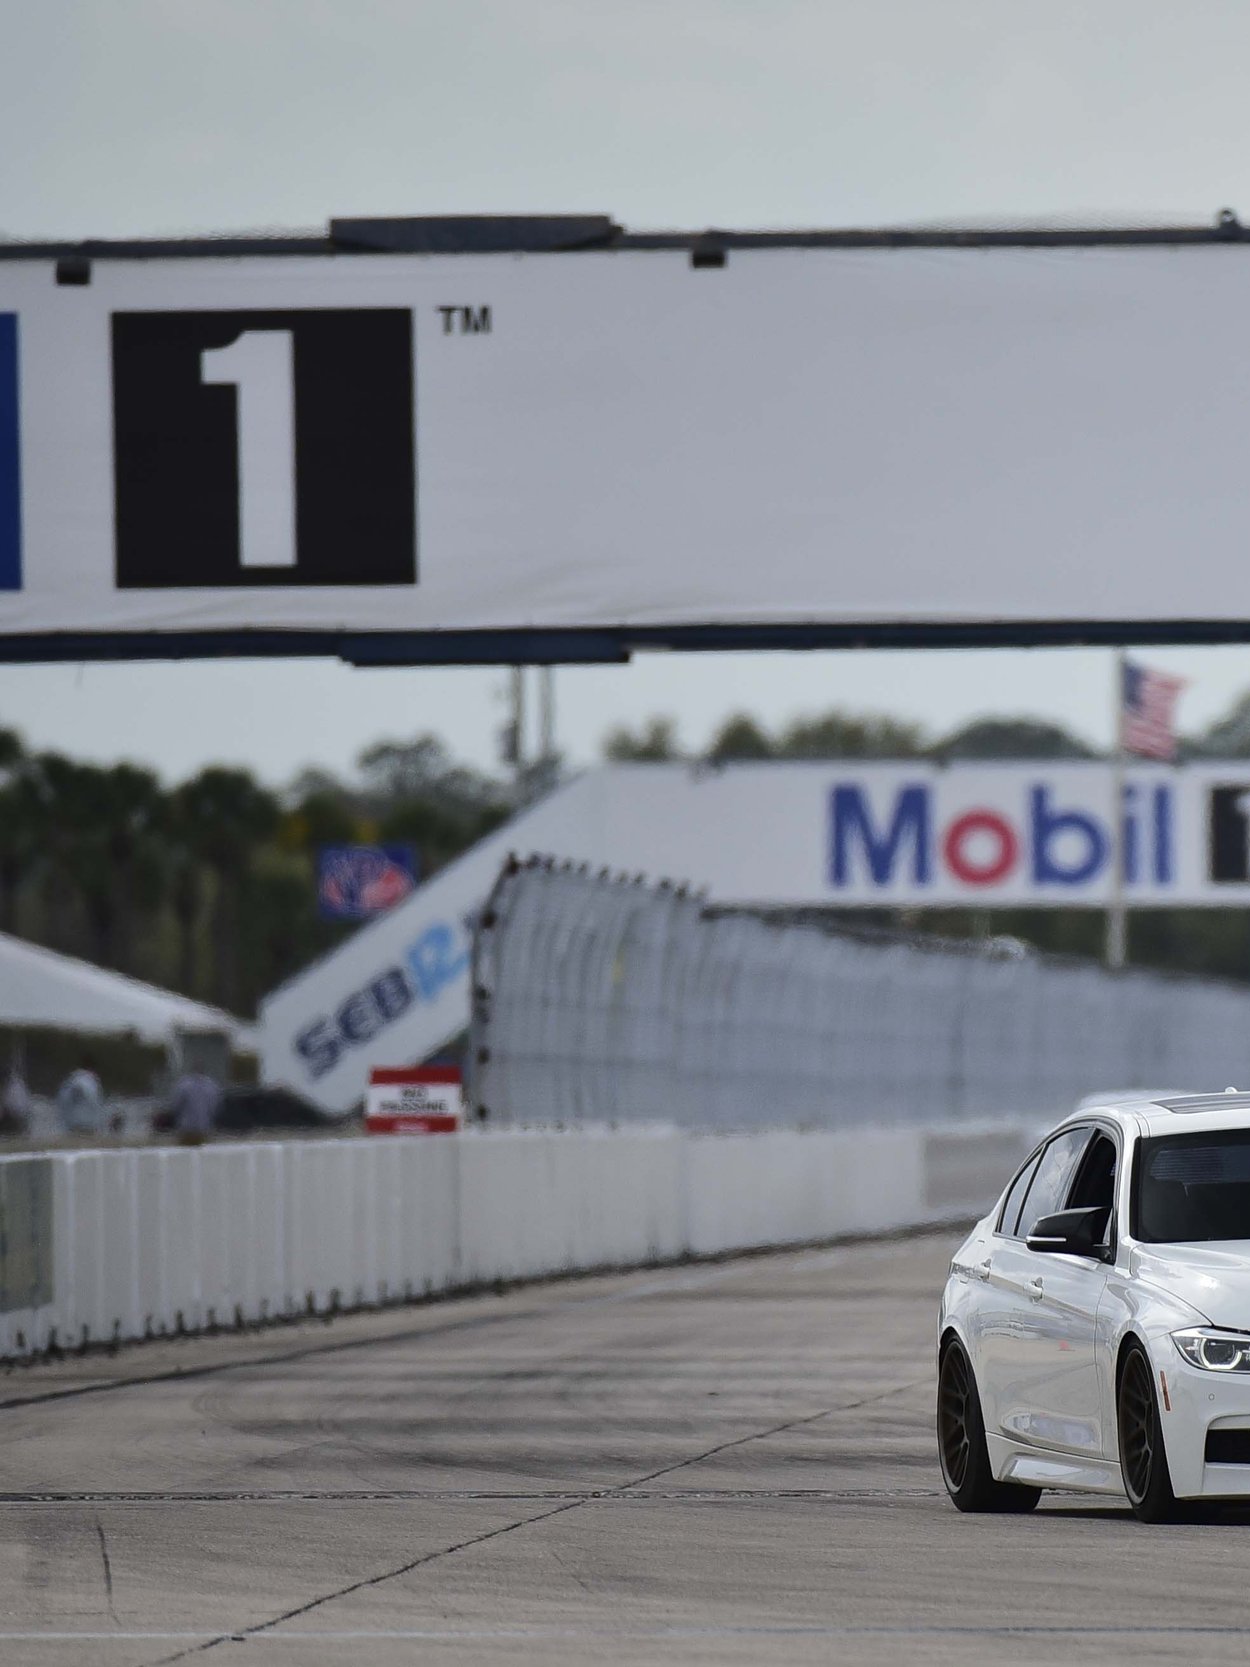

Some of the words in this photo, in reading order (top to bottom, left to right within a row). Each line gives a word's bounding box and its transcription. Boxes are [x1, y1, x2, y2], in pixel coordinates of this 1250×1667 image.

[201, 328, 298, 569] 1
[438, 304, 494, 335] TM
[829, 782, 1174, 888] Mobil
[295, 915, 474, 1081] SEBR
